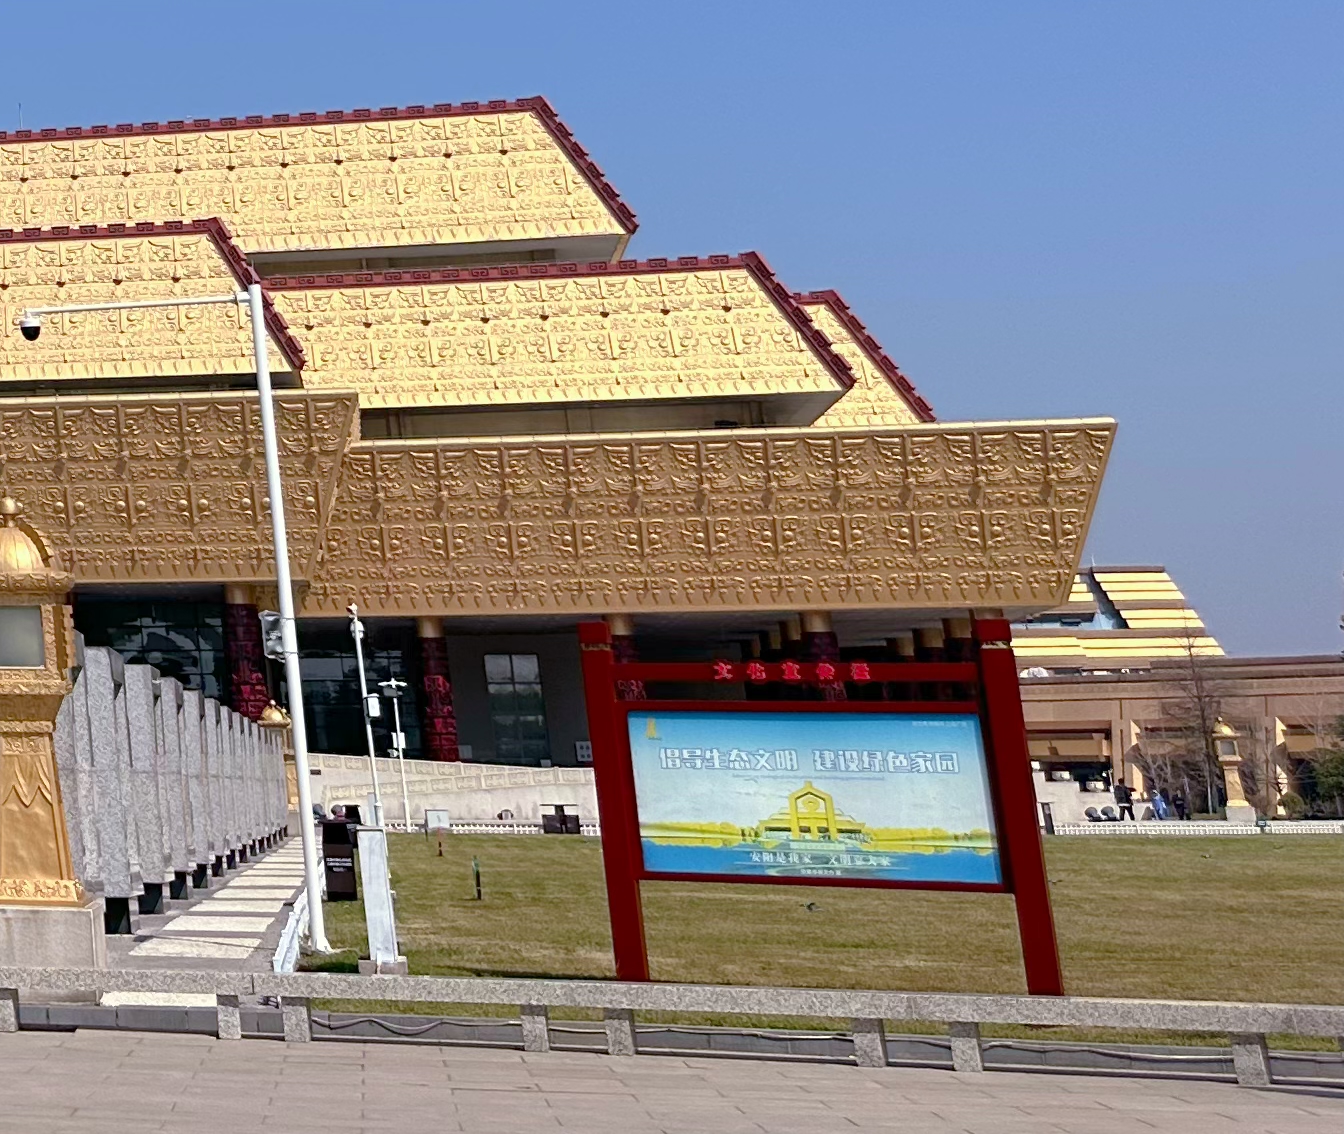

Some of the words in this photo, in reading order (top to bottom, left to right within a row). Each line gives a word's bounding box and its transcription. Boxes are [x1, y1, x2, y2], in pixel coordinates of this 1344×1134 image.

[658, 747, 799, 772] 倡导生态文明
[812, 749, 960, 775] 建设绿色家园
